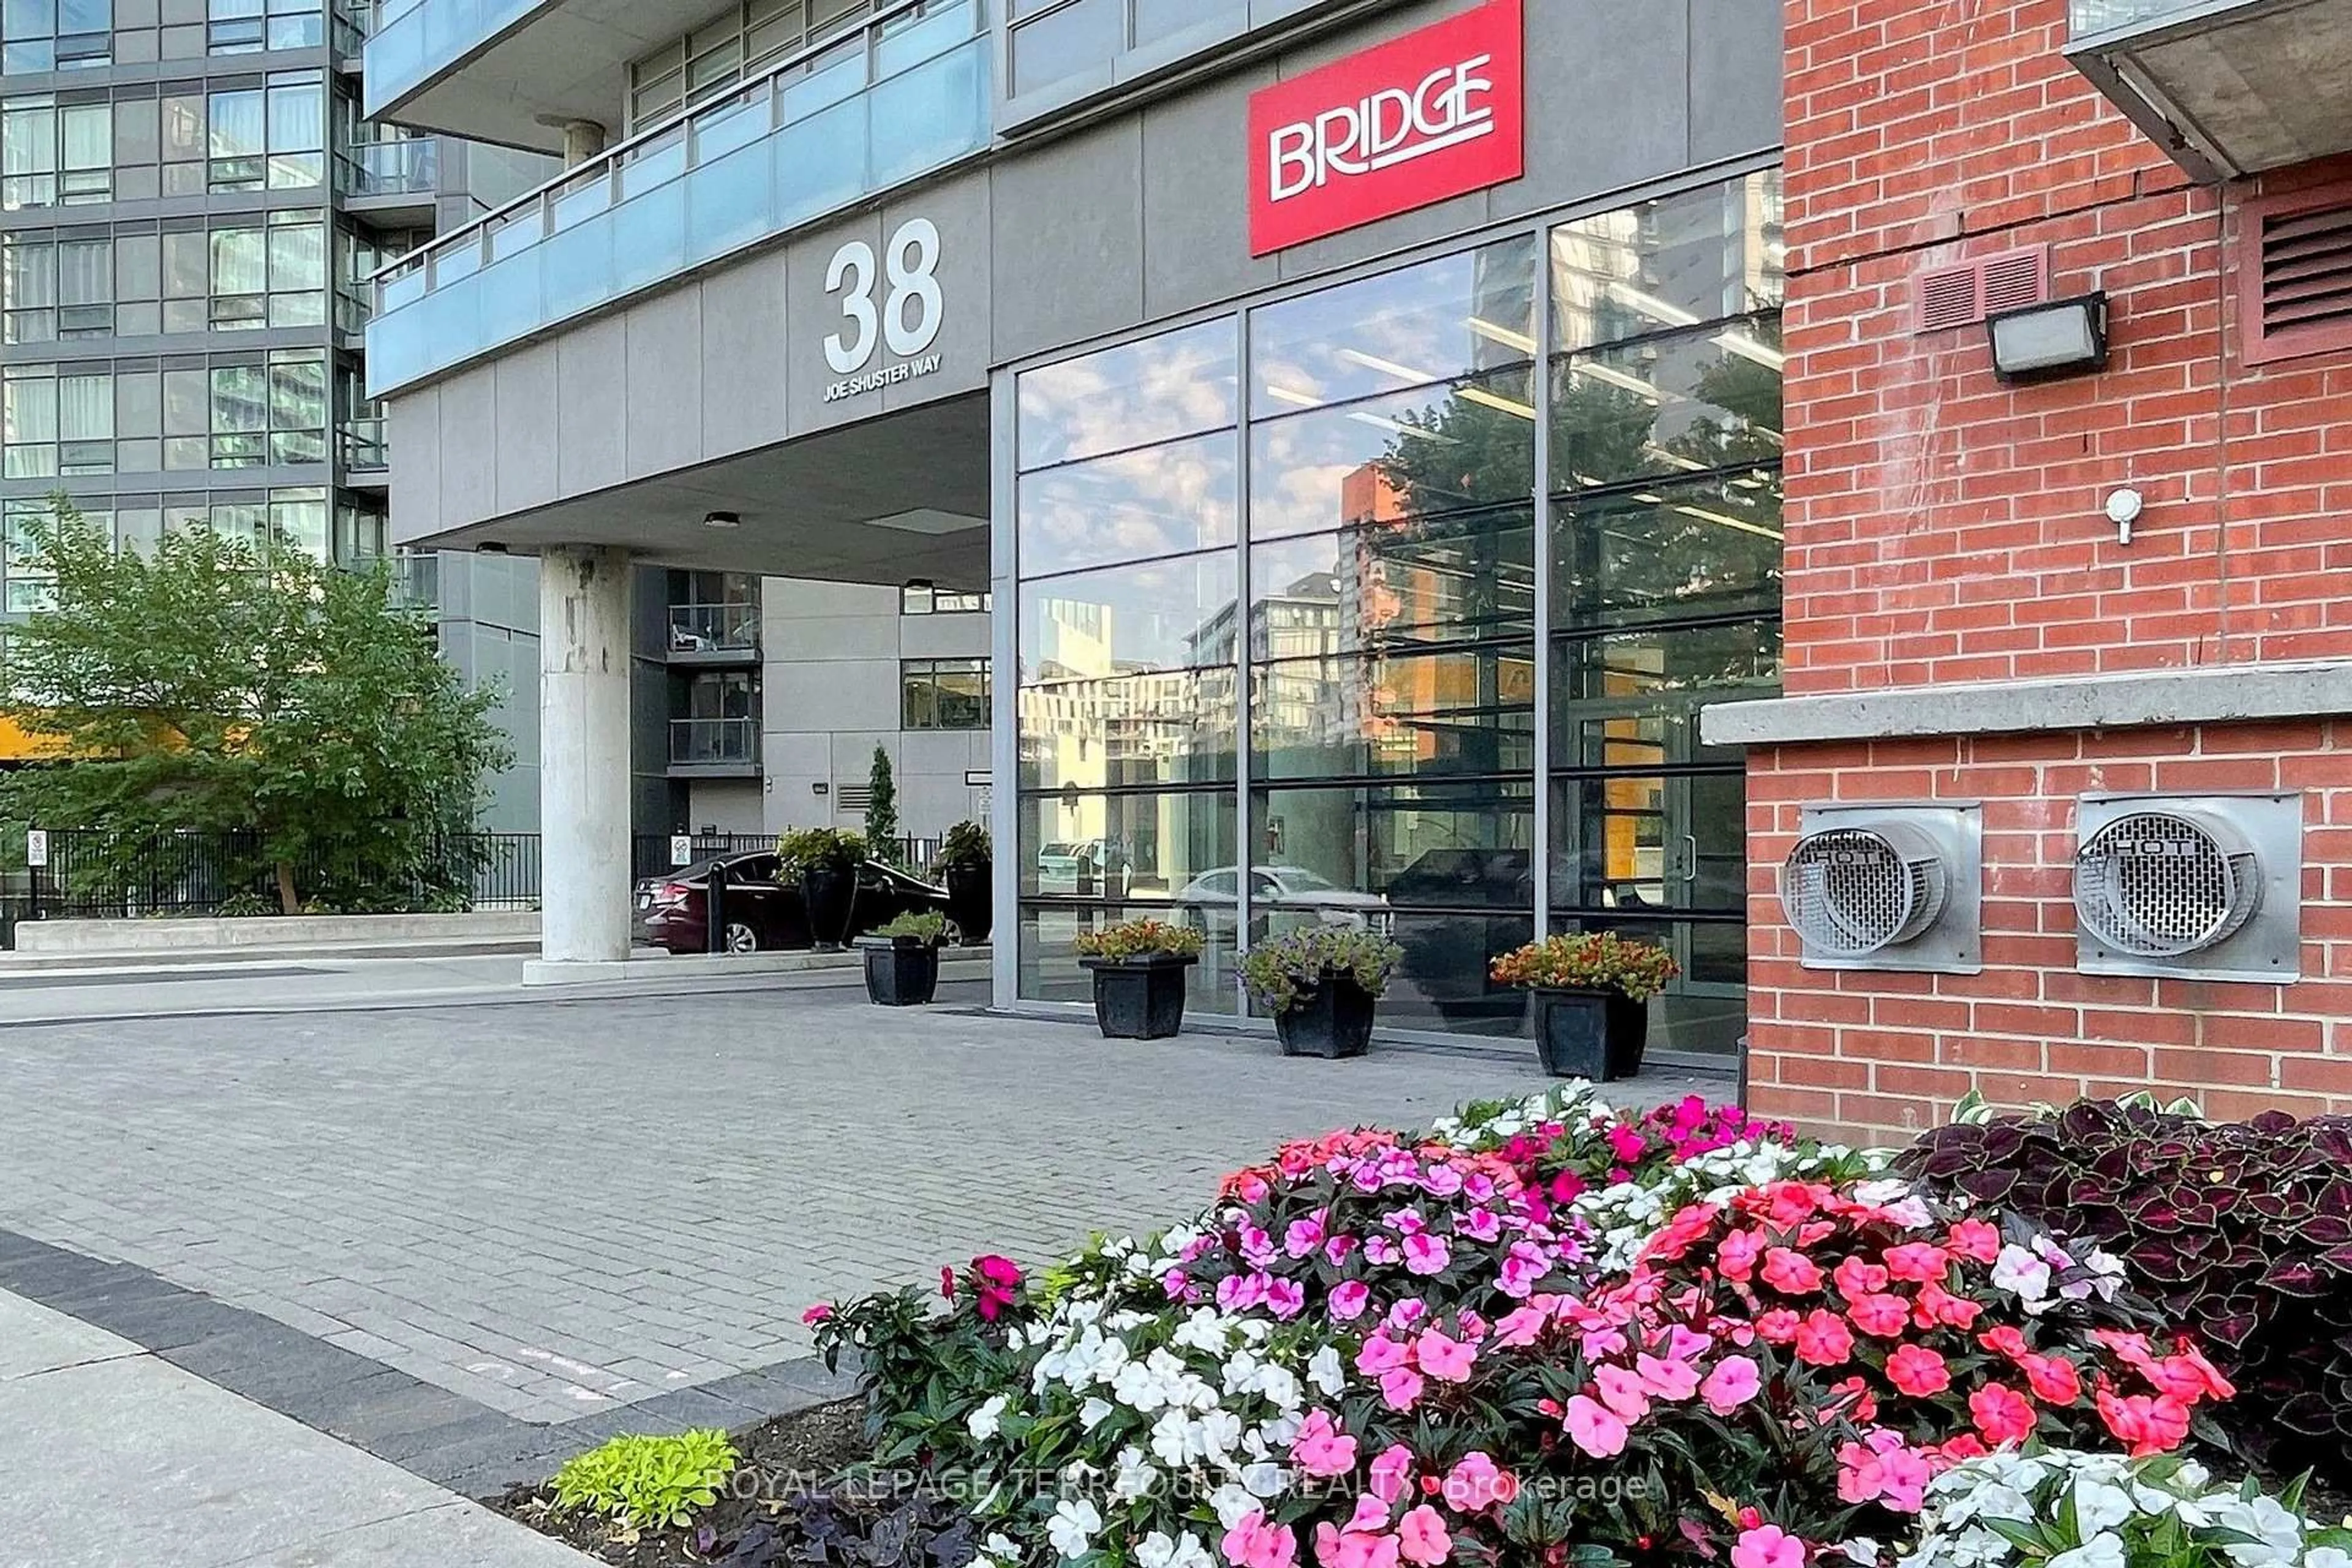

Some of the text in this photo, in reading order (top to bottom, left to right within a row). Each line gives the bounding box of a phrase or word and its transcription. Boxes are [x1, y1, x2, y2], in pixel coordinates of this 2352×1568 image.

[1268, 53, 1493, 202] BRIDGE
[823, 217, 944, 374] 38
[824, 353, 941, 402] JOE SHUSTER WAY
[1813, 851, 1875, 864] HOT
[2113, 840, 2190, 854] HOT
